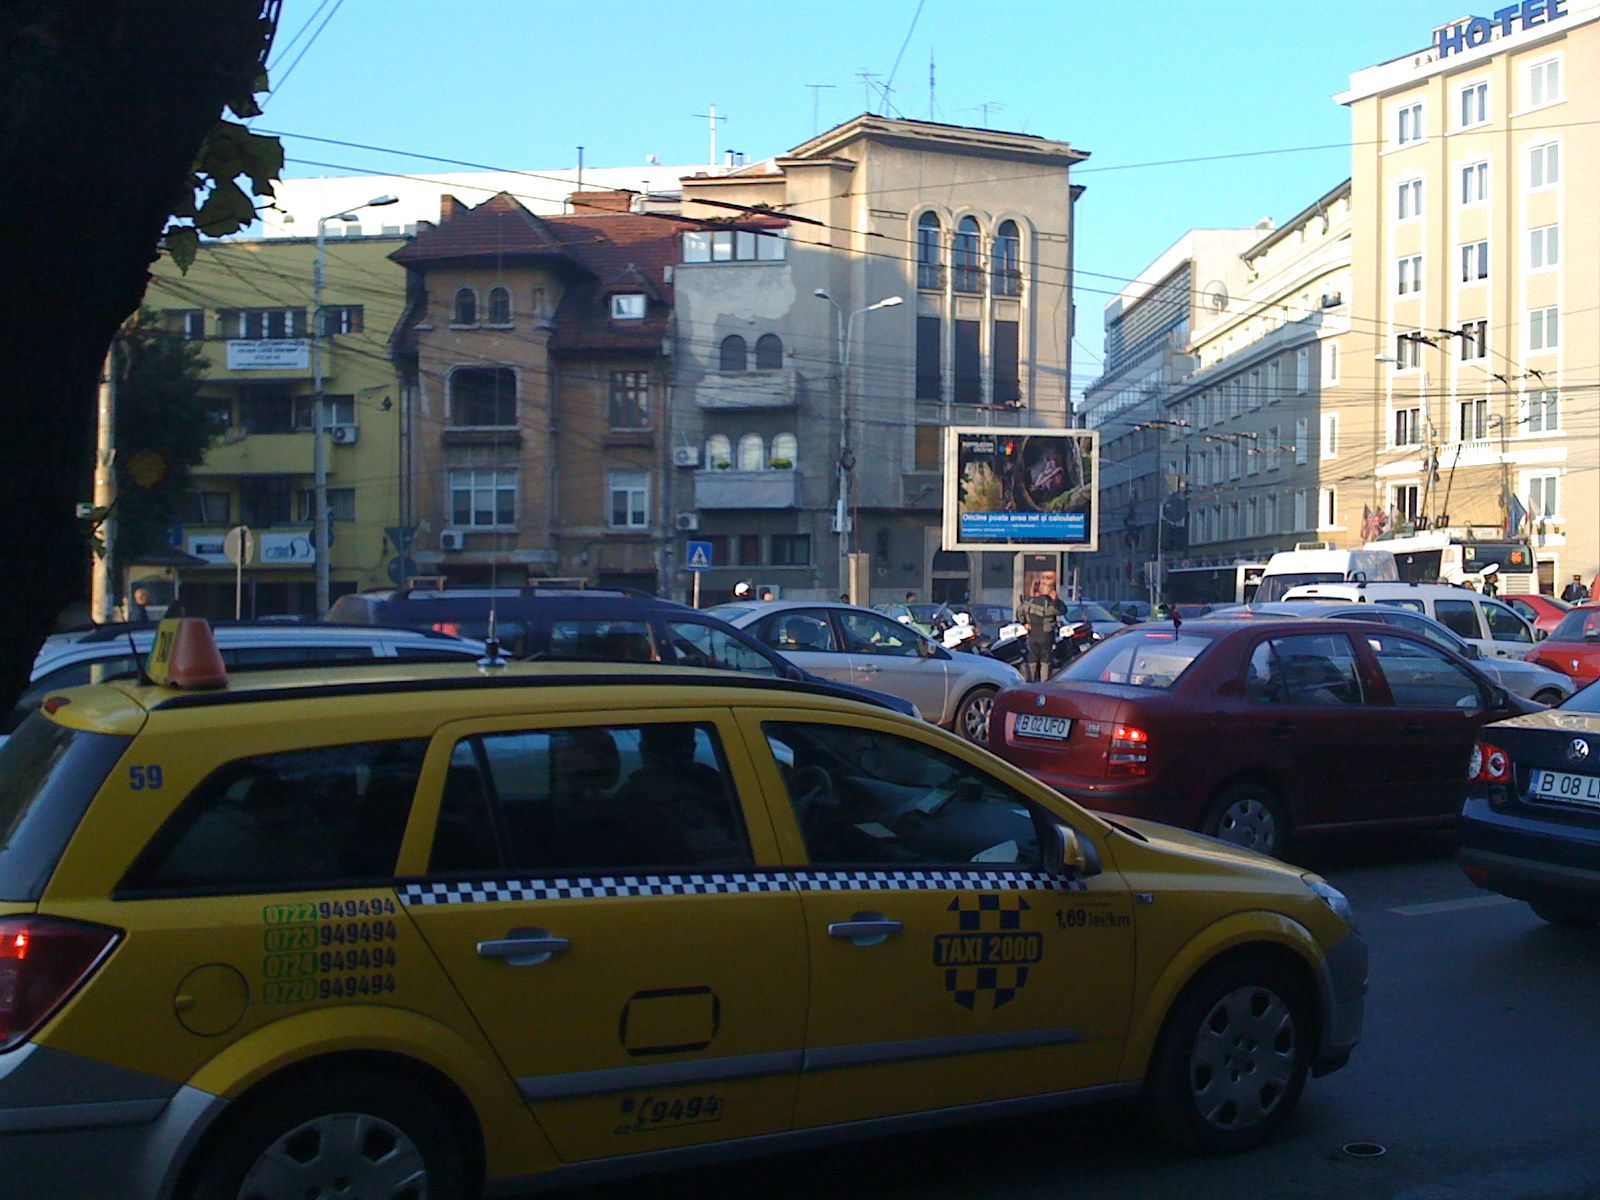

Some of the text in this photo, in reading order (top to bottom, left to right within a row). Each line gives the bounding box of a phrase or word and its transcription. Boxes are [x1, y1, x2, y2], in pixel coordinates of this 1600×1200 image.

[129, 764, 163, 791] 59
[1541, 773, 1555, 792] B
[1560, 776, 1582, 796] 08
[319, 898, 396, 919] 949494
[320, 920, 397, 945] 949494
[319, 946, 396, 973] 949494
[939, 935, 1039, 963] TAXI 2000
[319, 973, 396, 1000] 949494
